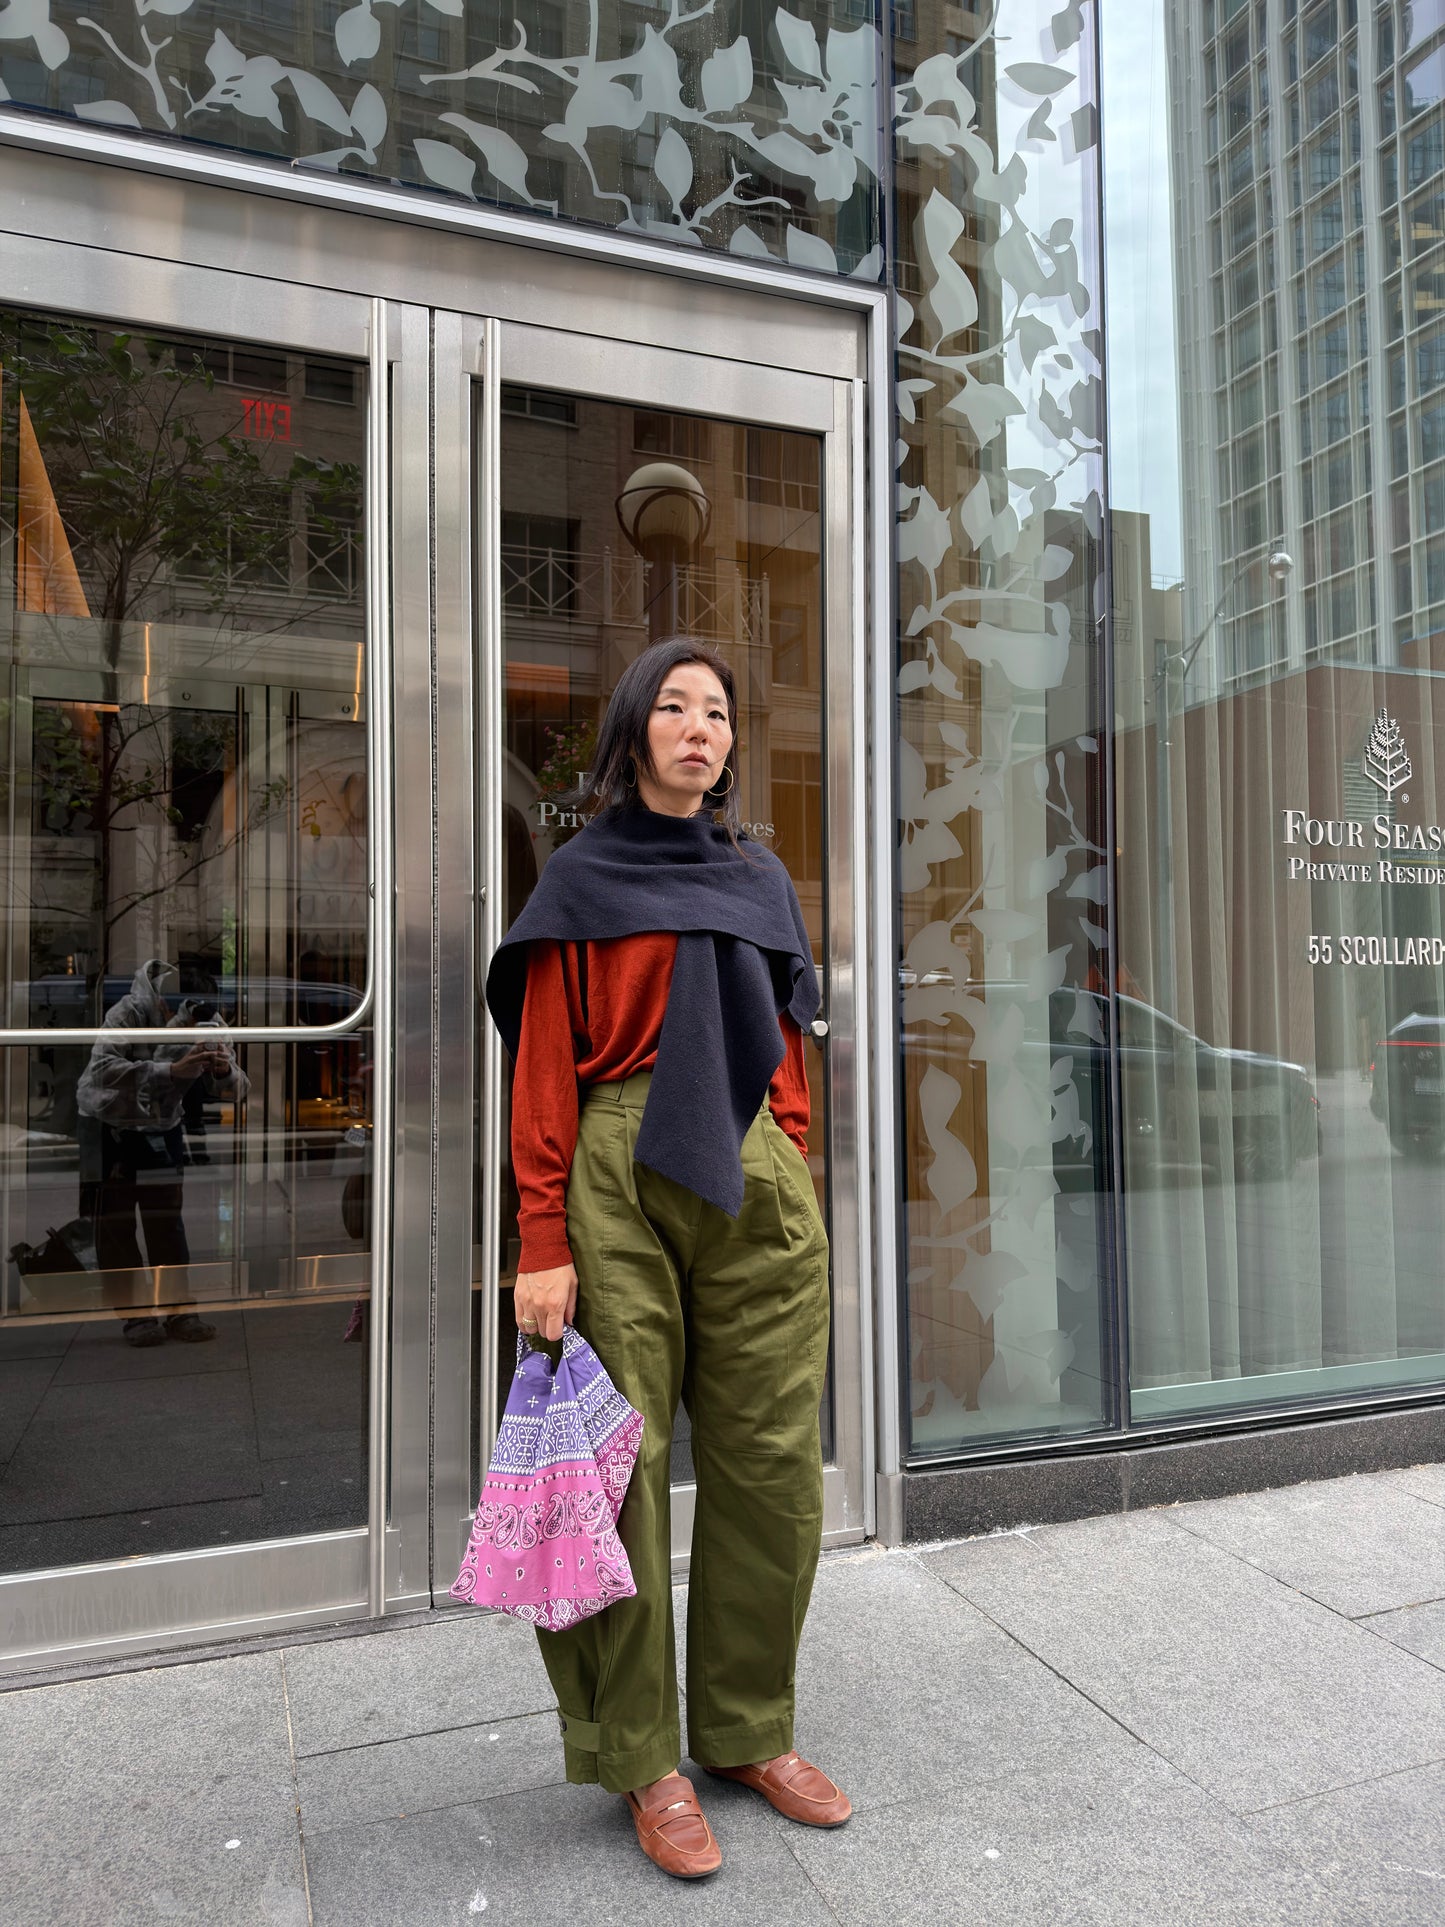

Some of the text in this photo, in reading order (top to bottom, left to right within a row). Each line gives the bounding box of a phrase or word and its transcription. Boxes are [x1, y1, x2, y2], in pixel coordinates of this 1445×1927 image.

[537, 801, 595, 828] Priv
[1282, 809, 1445, 851] FOUR SEAS
[1287, 856, 1372, 883] PRIVATE
[1307, 935, 1443, 966] 55 SCOLLARD
